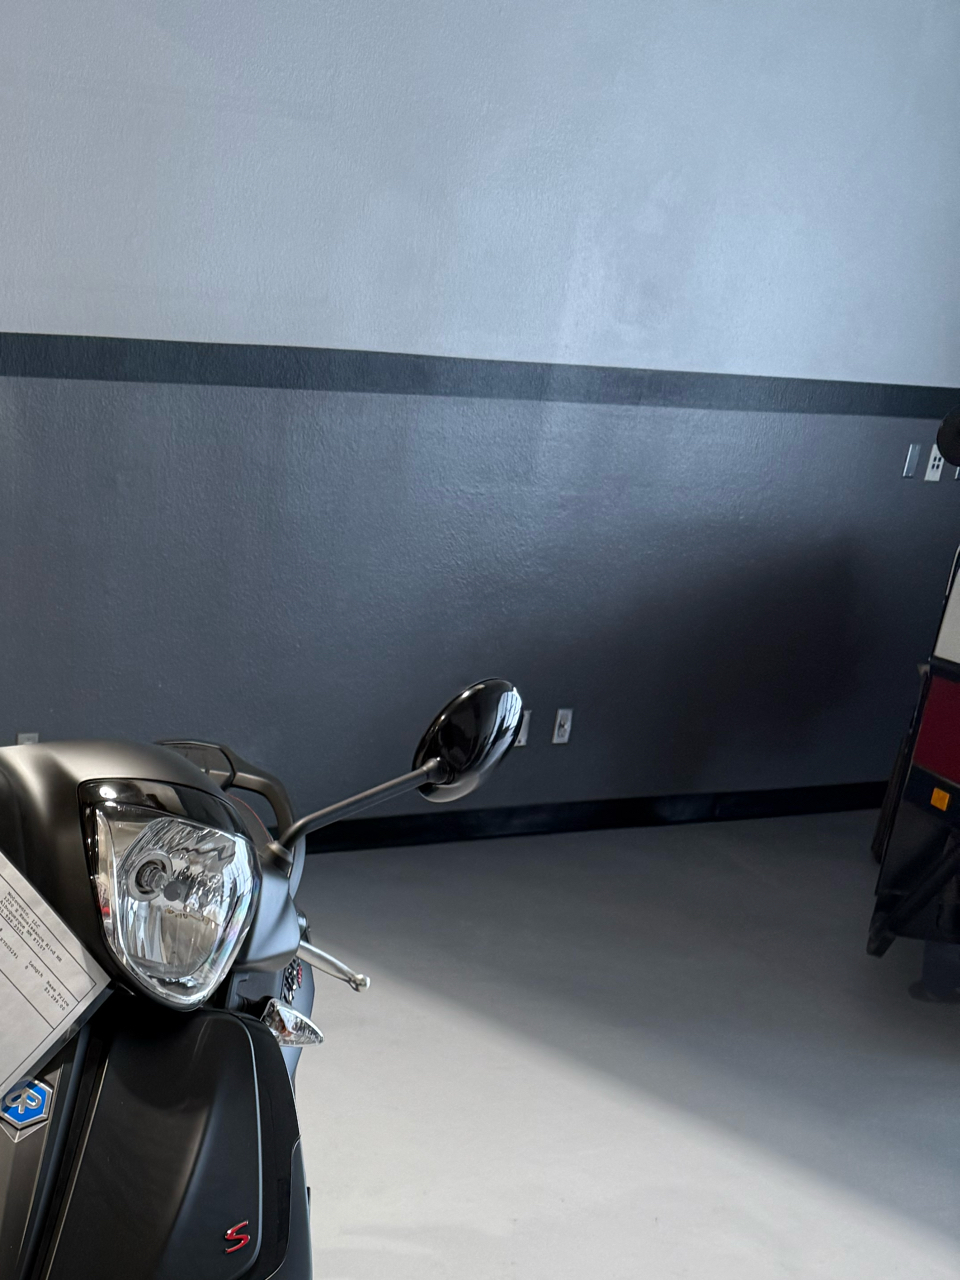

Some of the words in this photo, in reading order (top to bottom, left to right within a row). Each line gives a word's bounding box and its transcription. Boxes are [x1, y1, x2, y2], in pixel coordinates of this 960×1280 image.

[26, 960, 44, 979] Length
[45, 980, 57, 992] Base
[56, 992, 70, 1007] Price
[224, 1220, 251, 1254] S
